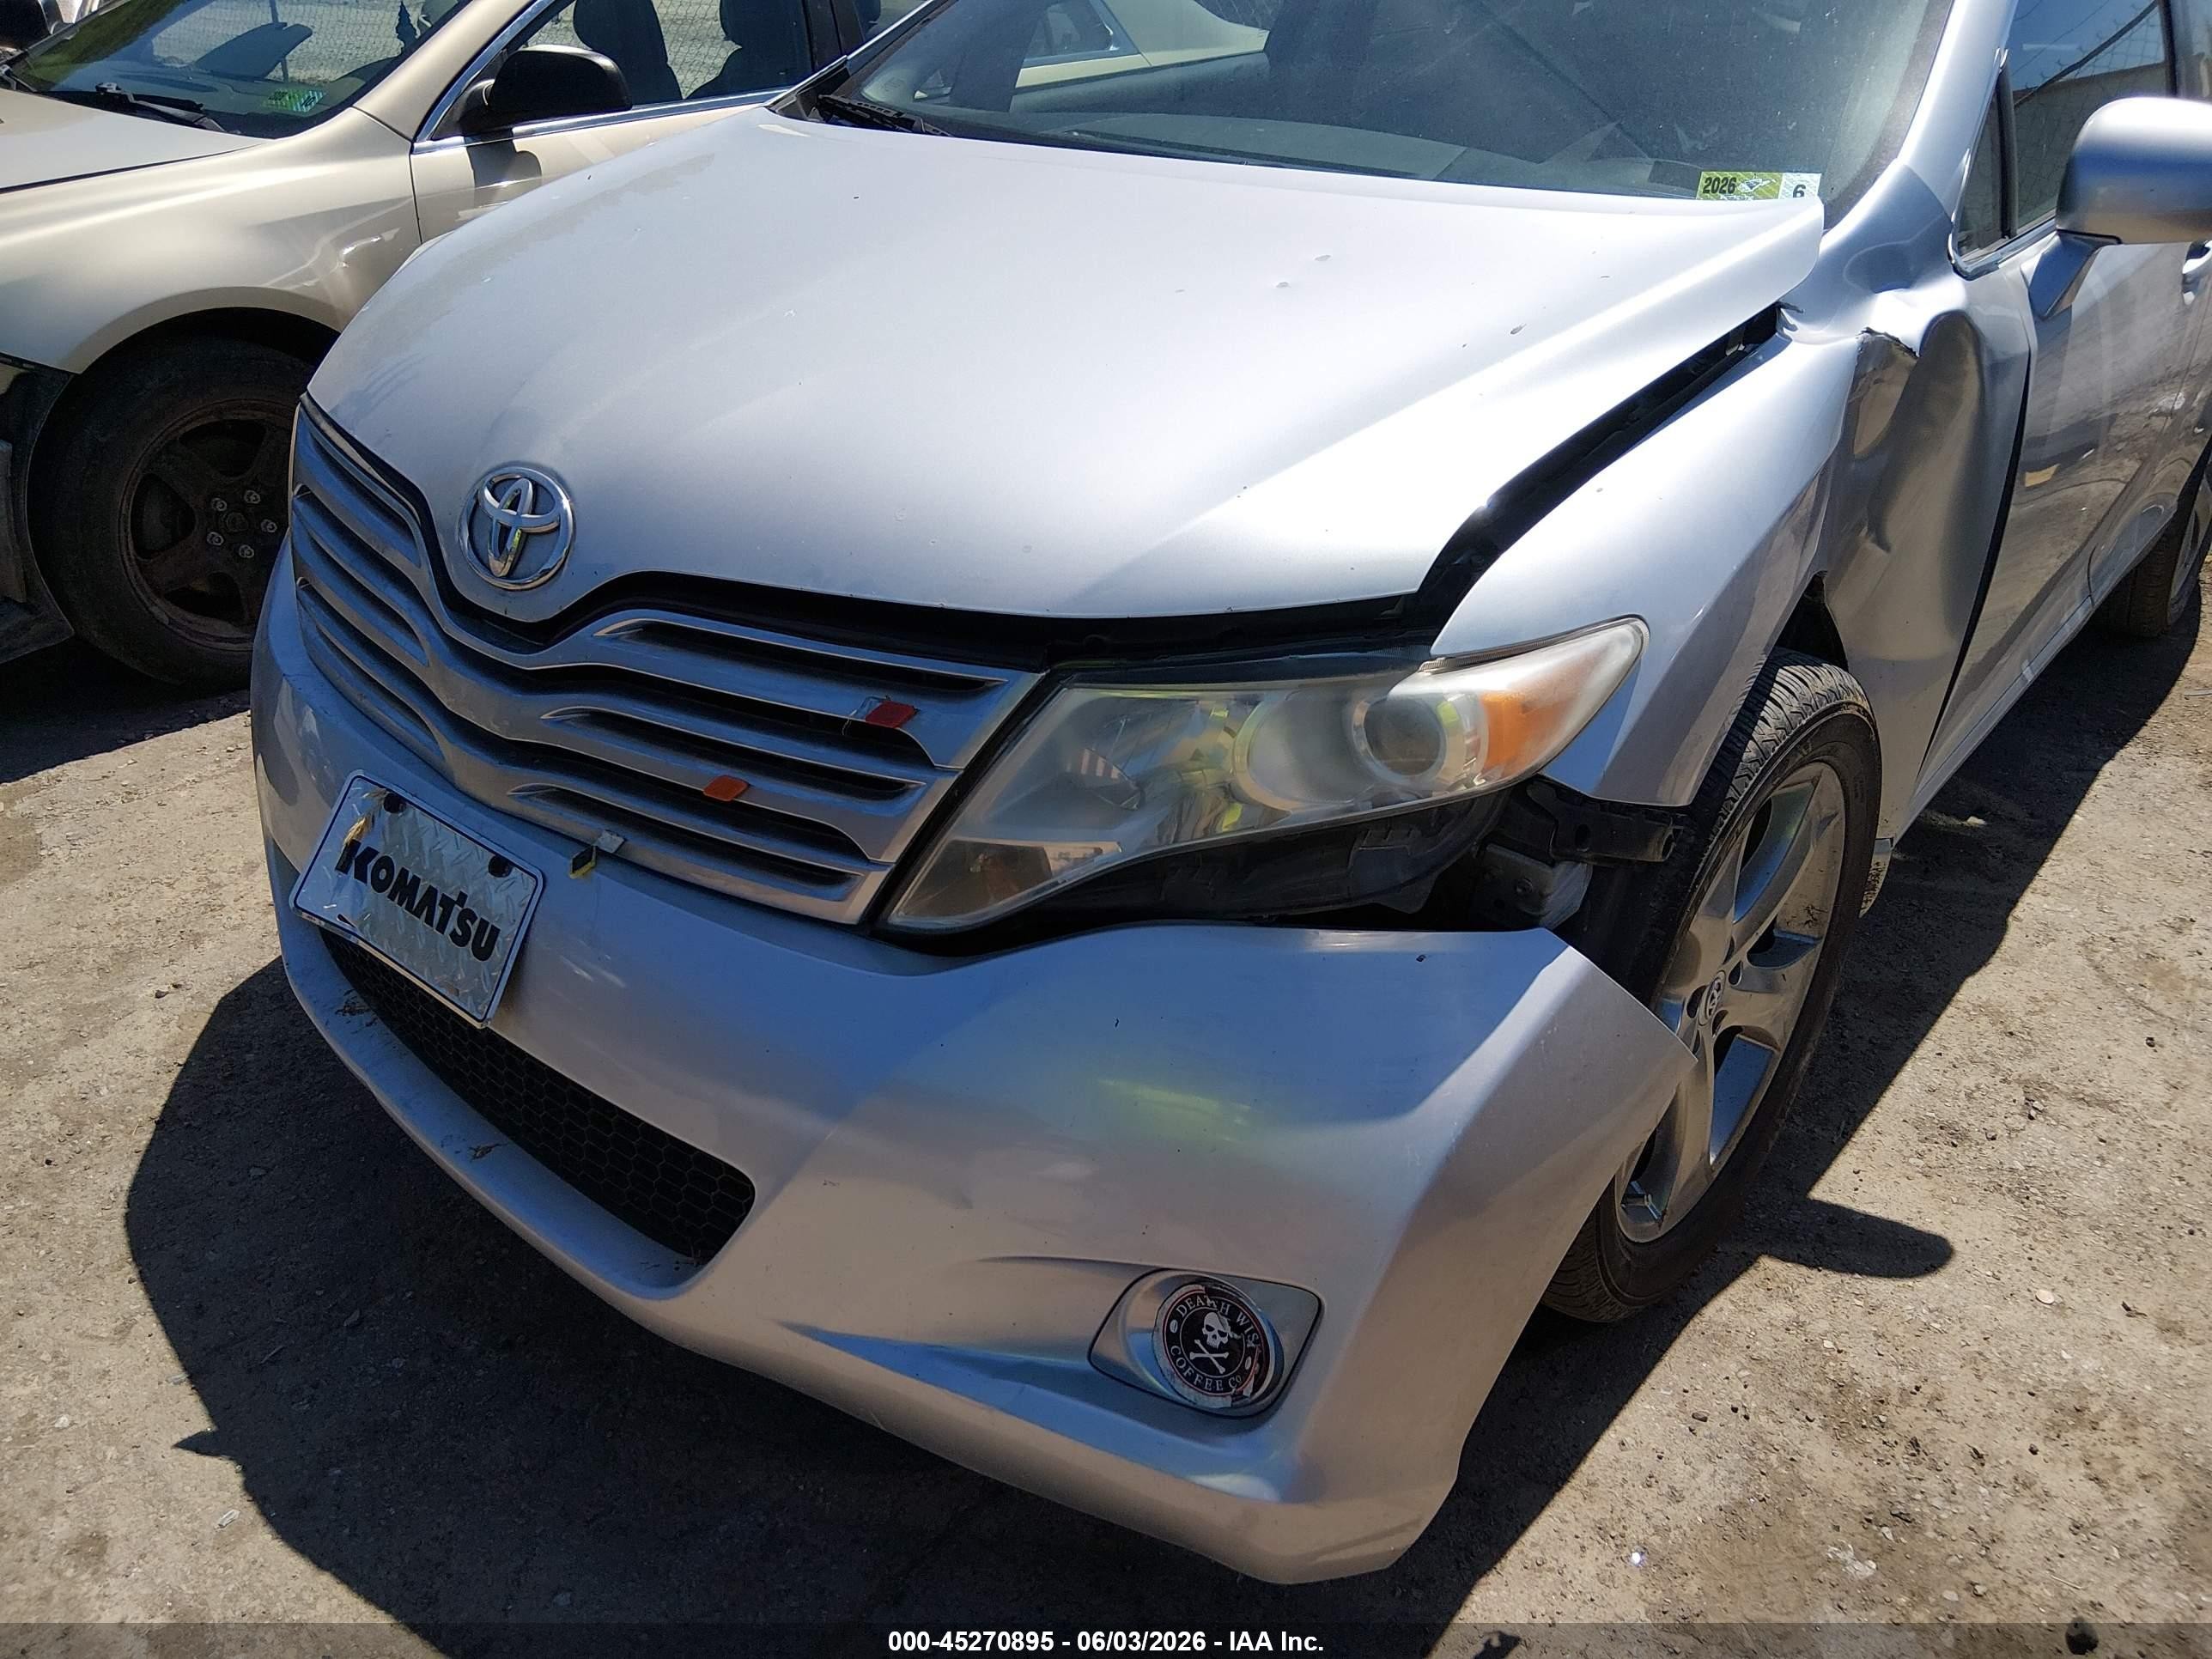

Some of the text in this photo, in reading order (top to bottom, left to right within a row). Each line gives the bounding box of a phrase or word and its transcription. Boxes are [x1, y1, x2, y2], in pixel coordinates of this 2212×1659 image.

[1702, 176, 1737, 194] 2026
[1792, 184, 1807, 198] 6
[334, 838, 501, 962] KOMATSU
[1176, 1294, 1261, 1347] DEATH WIS
[1170, 1345, 1224, 1391] COFFEE
